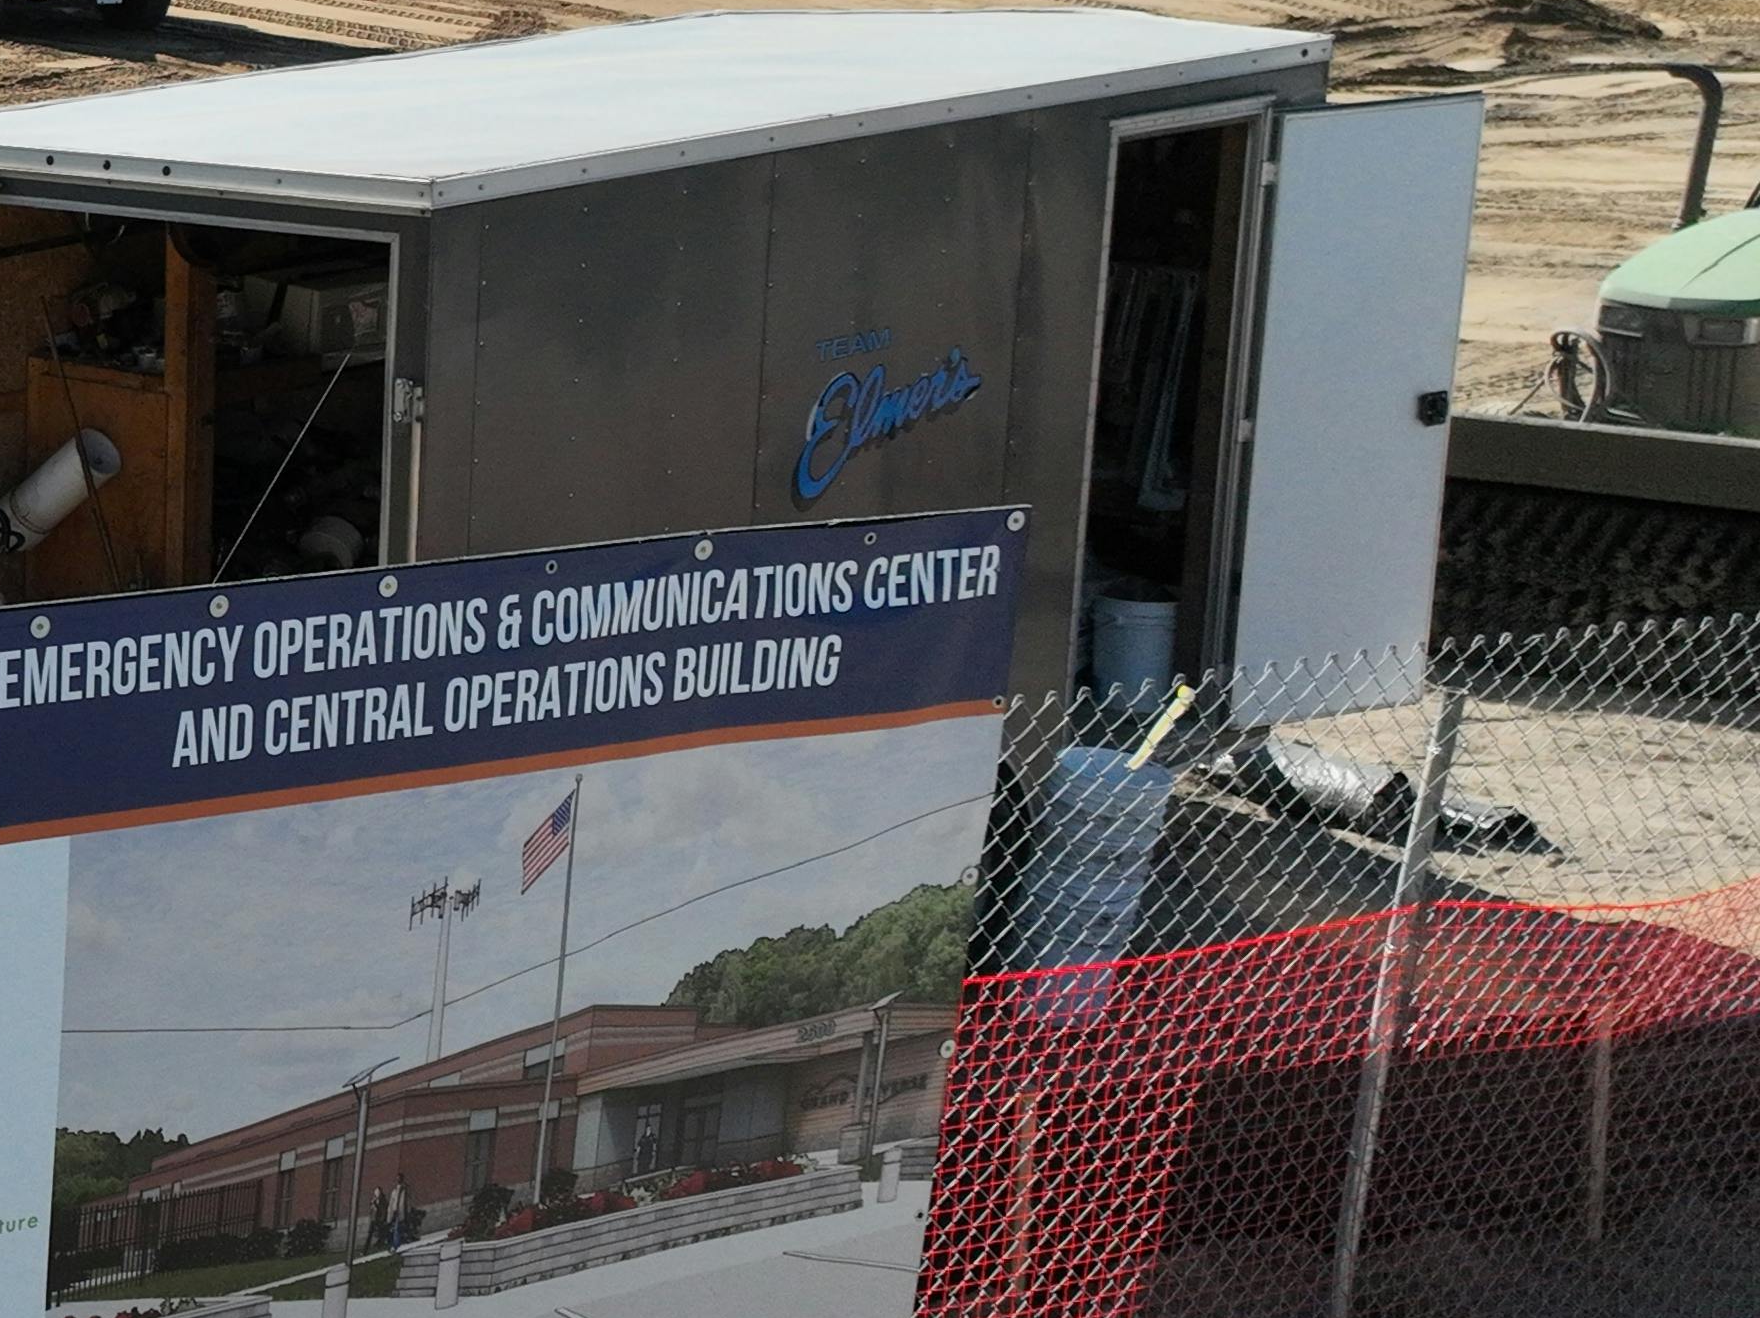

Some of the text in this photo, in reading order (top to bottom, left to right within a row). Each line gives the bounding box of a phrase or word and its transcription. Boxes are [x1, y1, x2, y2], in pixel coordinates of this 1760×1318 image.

[816, 328, 893, 362] TEAM
[794, 345, 982, 504] Elmer's
[253, 597, 488, 679] OPERATIONS
[497, 594, 522, 650] &
[531, 560, 858, 647] COMMUNICATIONS
[863, 544, 1001, 610] CENTER
[172, 634, 843, 768] AND CENTRAL OPERATIONS BUILDING
